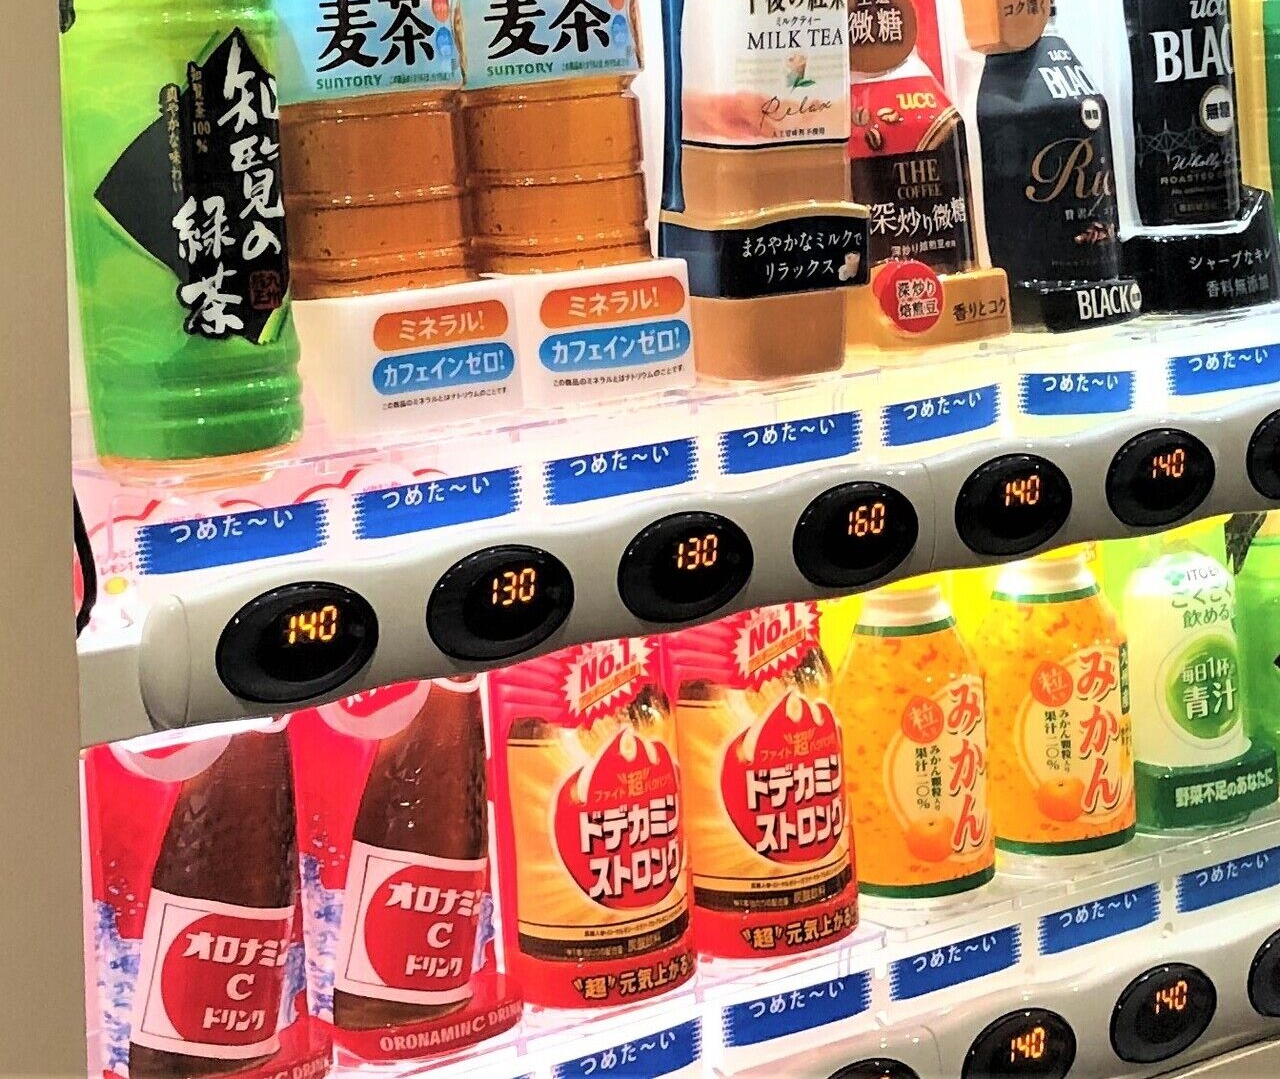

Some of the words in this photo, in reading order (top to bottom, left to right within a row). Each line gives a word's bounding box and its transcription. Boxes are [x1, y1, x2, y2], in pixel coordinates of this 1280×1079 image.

[777, 16, 821, 26] ミルクティー
[848, 8, 903, 45] 微糖
[747, 30, 802, 50] MILK
[807, 28, 844, 46] TEA
[1047, 49, 1072, 62] UCC
[316, 73, 382, 90] SUNTORY
[487, 61, 554, 77] SUNTORY
[758, 96, 832, 129] Relax
[896, 93, 937, 110] UCC
[217, 35, 286, 261] 知覧の
[892, 159, 940, 185] THE
[897, 184, 942, 199] COFFEE
[742, 229, 862, 259] まろやかなミルクで
[172, 195, 244, 334] 緑茶
[765, 262, 835, 284] リラックス
[567, 287, 660, 318] ミネラル!
[953, 297, 1006, 320] 香りとコク
[1076, 284, 1131, 320] BLACK
[398, 310, 486, 342] ミネラル!
[552, 327, 681, 365] カフェインゼロ!
[383, 349, 505, 387] カフェインゼロ!
[1150, 448, 1185, 479] 140
[1002, 473, 1041, 507] 140
[846, 503, 886, 538] 160
[676, 533, 718, 570] 130
[491, 567, 536, 605] 130
[287, 605, 338, 644] 140
[748, 605, 803, 658] No.1
[1183, 603, 1230, 628] 飲める
[580, 638, 629, 693] No.1
[1183, 678, 1238, 720] 青汁
[1077, 651, 1121, 814] みかん
[745, 755, 841, 810] ドデカミン
[947, 685, 987, 853] みかん
[1175, 768, 1273, 808] 野菜不足のあなたに
[579, 798, 679, 854] ドデカミン
[755, 800, 844, 855] ストロング
[589, 845, 680, 899] ストロング
[426, 922, 452, 948] C
[405, 954, 463, 979] ドリンク
[227, 973, 257, 1001] C
[1153, 981, 1187, 1013] 140
[203, 1007, 266, 1032] ドリンク
[1010, 1027, 1046, 1065] 140
